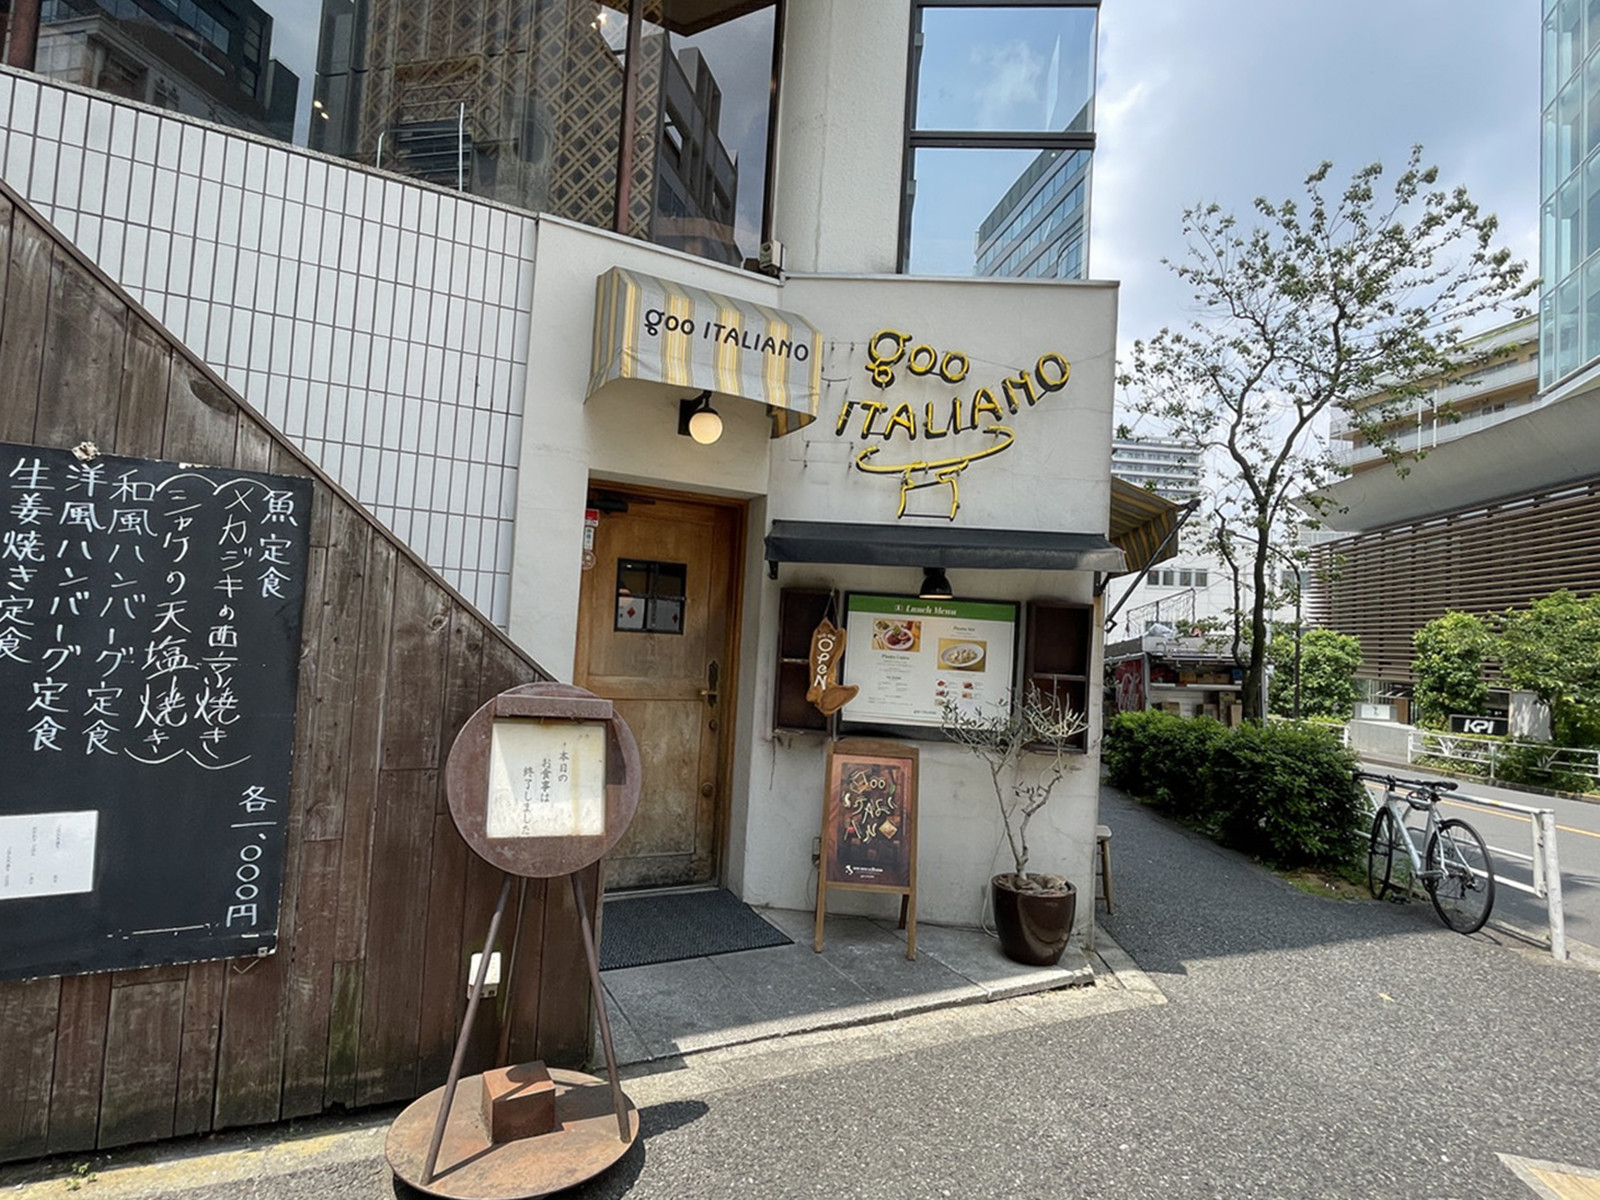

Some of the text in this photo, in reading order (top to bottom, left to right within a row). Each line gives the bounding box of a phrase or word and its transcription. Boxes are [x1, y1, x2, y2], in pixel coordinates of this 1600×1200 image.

[644, 308, 809, 362] goo ITALIANO
[865, 328, 970, 390] goo
[835, 352, 1071, 440] ITALIANO
[0, 457, 55, 664] 生姜焼き定食
[257, 490, 299, 599] 魚定食
[27, 463, 108, 751] 洋風ハンバーグ定食
[82, 468, 158, 755] 和風ハンバーグ定食
[1462, 718, 1495, 734] KPI
[521, 766, 535, 836] 終了しました
